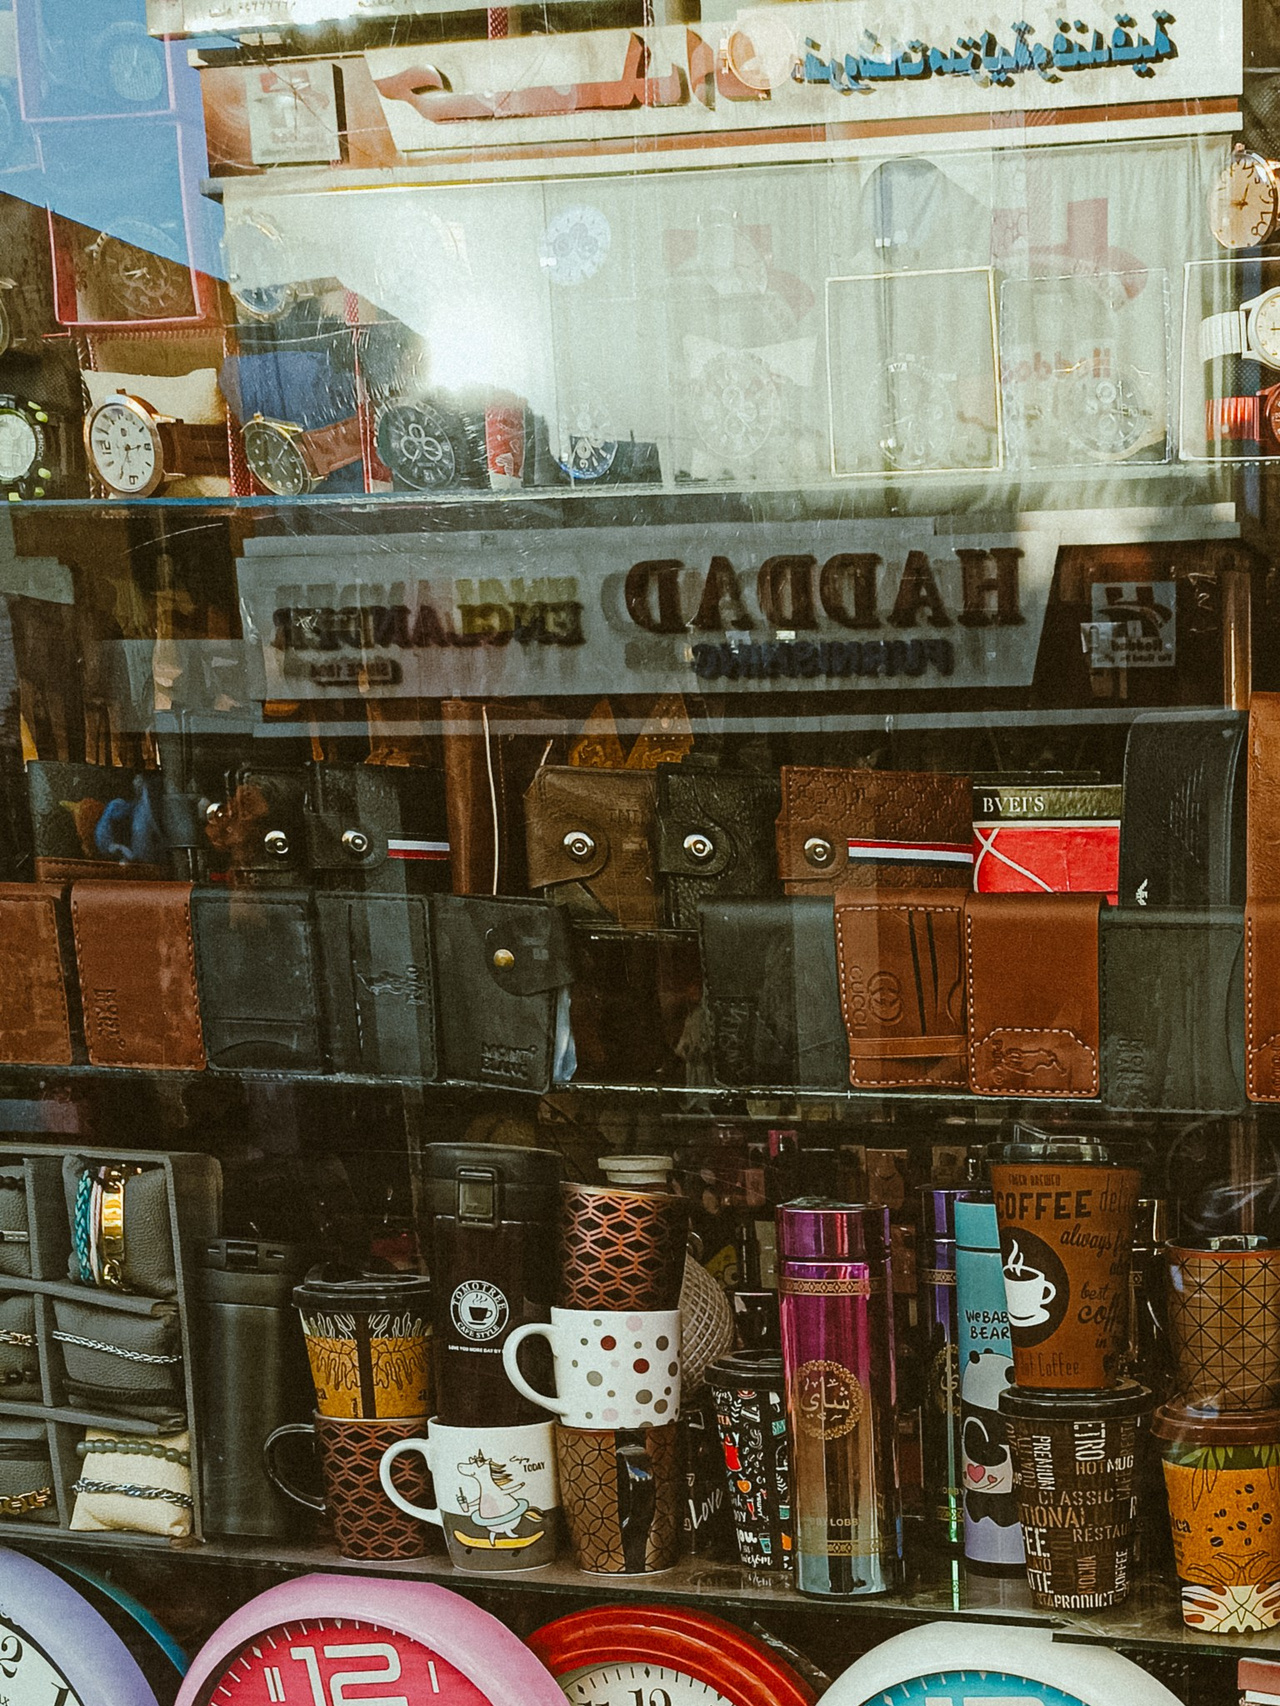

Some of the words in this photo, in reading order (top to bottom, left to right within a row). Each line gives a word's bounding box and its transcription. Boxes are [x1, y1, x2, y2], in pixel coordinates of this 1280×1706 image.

[982, 795, 1045, 813] BVEI'S
[850, 965, 868, 1032] GUCCI
[996, 1189, 1093, 1221] COFFEE
[1060, 1223, 1112, 1258] always
[452, 1279, 507, 1311] TOMOTREE
[1081, 1280, 1108, 1300] best
[457, 1320, 476, 1338] CAFE
[475, 1324, 501, 1340] STYLE
[1038, 1350, 1080, 1377] Coffee
[523, 1462, 545, 1473] TODAY
[1032, 1434, 1056, 1491] PREMIUM
[1075, 1460, 1105, 1475] HOT
[1106, 1454, 1134, 1473] MUG
[1038, 1488, 1115, 1507] CLASSIC
[1077, 1555, 1097, 1595] MOCHA
[1054, 1590, 1115, 1609] PRODUCT
